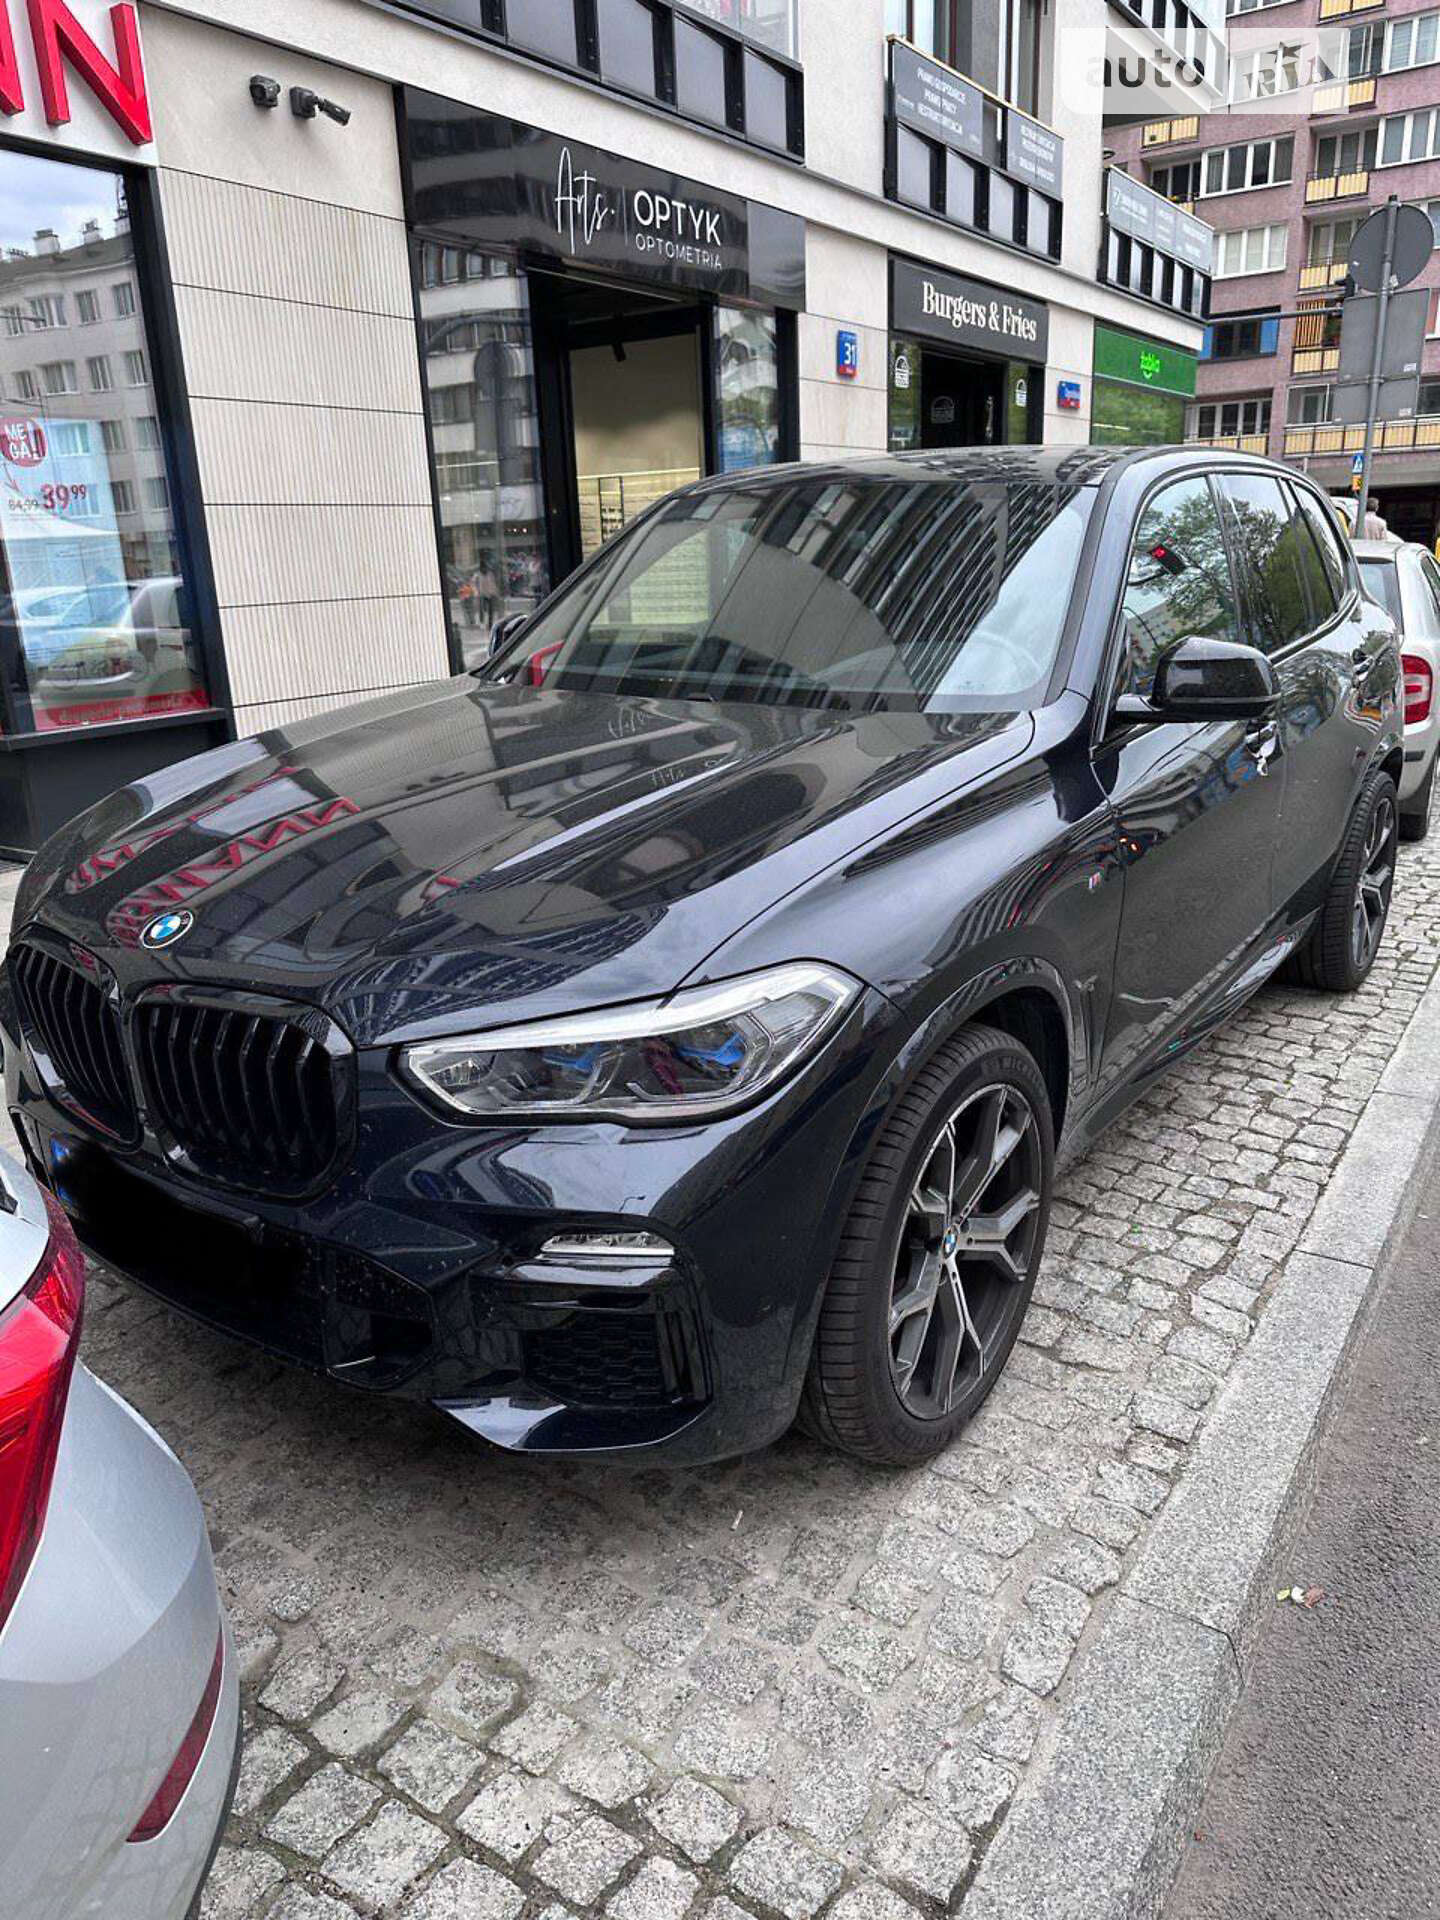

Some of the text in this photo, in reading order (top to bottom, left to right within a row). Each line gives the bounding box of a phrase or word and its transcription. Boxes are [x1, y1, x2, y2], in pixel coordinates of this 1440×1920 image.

[633, 190, 721, 246] OPTYK
[635, 233, 722, 270] OPTOMETRIA
[922, 281, 1037, 341] Burgers & Fries
[844, 342, 858, 365] 31
